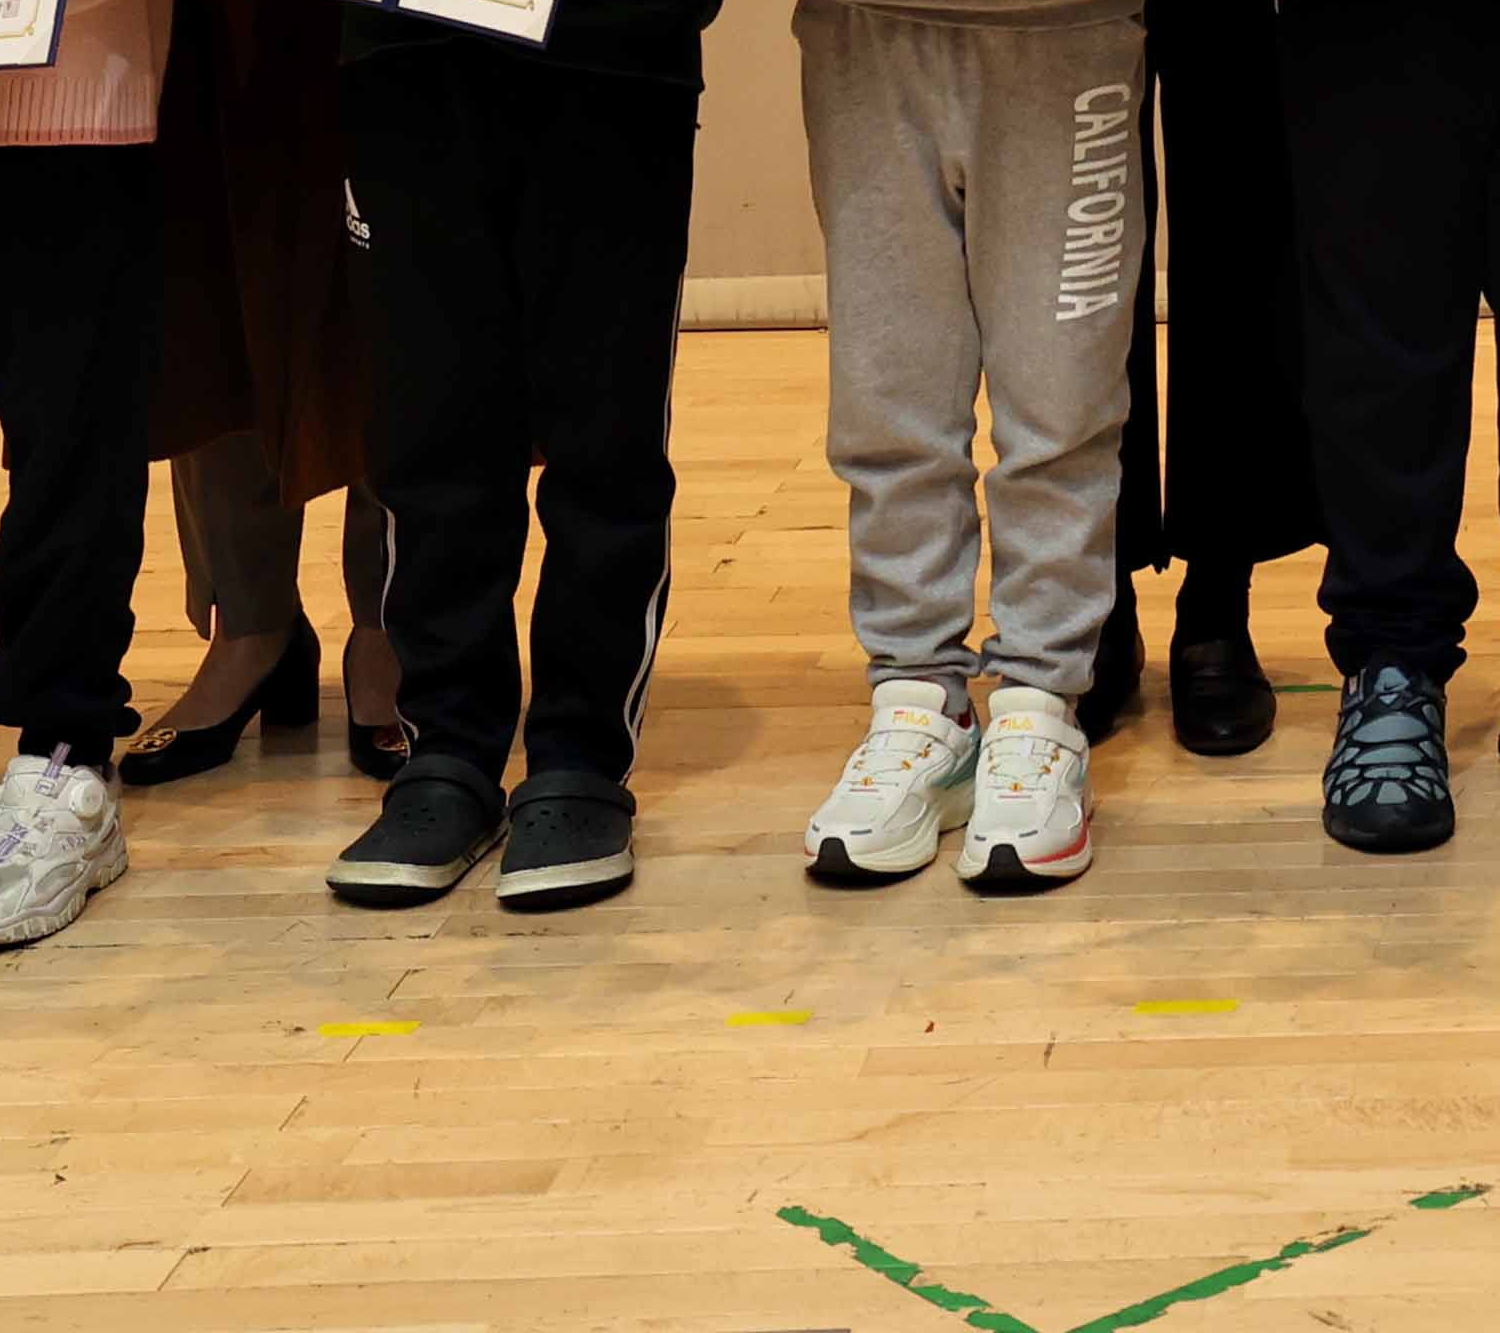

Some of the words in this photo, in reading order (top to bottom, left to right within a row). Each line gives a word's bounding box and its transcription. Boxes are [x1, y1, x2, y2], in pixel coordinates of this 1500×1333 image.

[1054, 83, 1132, 322] CALIFORNIA
[891, 709, 932, 727] FILA
[997, 717, 1035, 732] FILA
